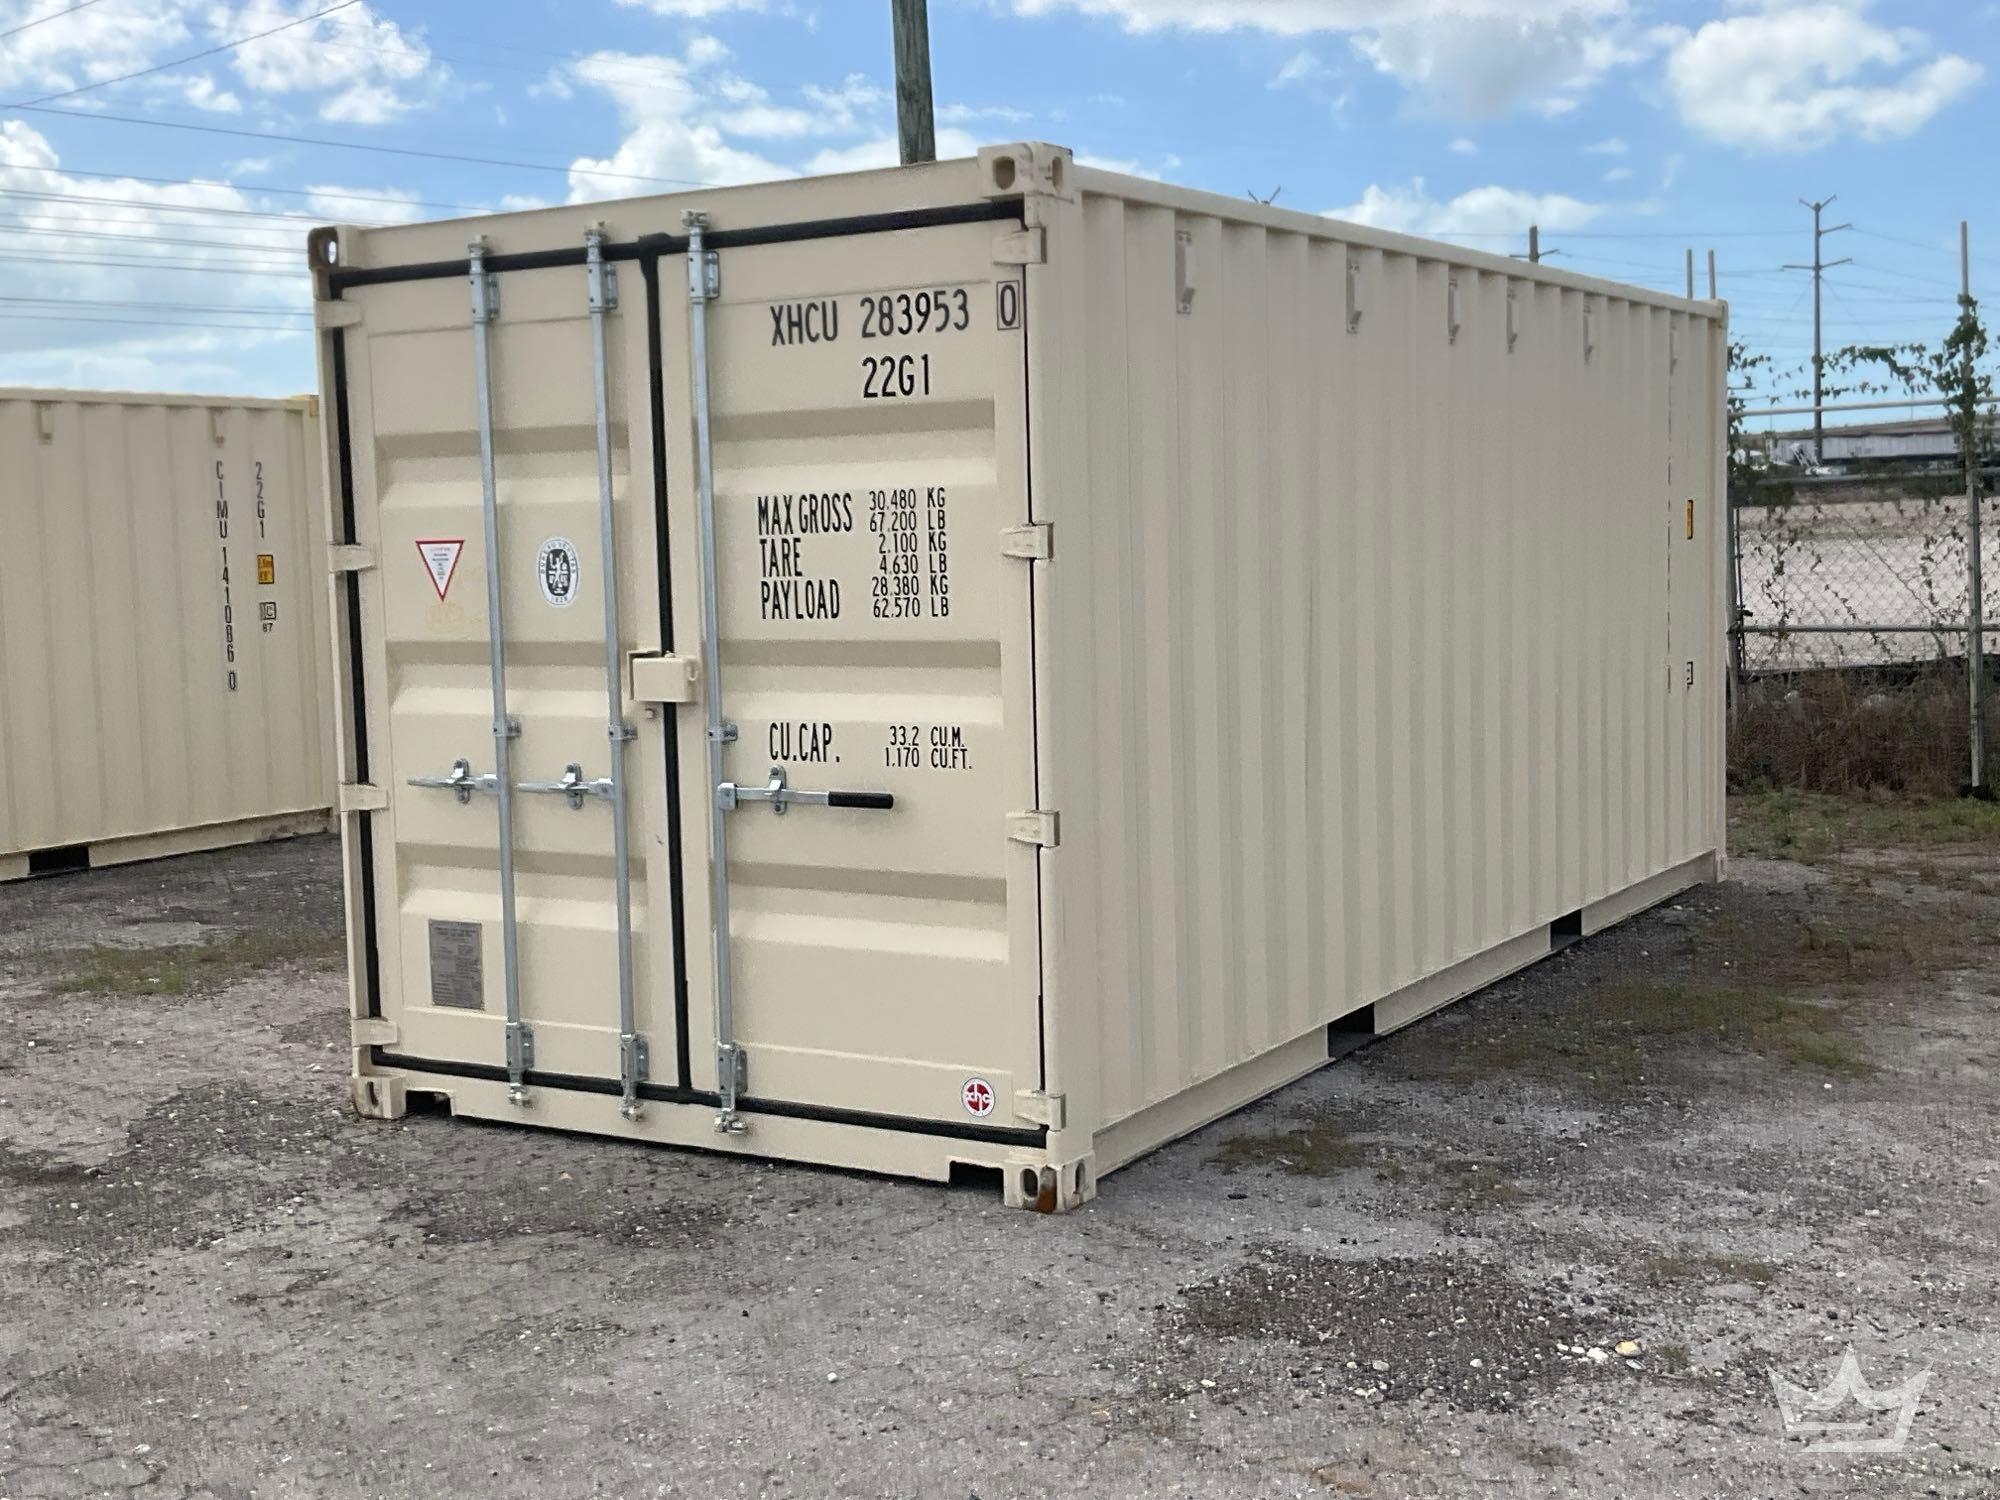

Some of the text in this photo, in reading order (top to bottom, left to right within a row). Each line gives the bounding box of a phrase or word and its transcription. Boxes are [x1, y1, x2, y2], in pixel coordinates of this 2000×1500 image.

[769, 284, 1016, 346] XHCU 283953 0
[861, 354, 929, 398] 22G1
[215, 461, 228, 539] CIMU
[255, 461, 266, 538] 22G1
[757, 493, 853, 535] MAX GROSS
[869, 487, 946, 511] 30.480 KG
[869, 509, 946, 533] 67.200 LB
[759, 537, 803, 577] TARE
[878, 531, 947, 554] 2.100 KG
[879, 553, 948, 575] 4.630 LB
[760, 579, 841, 620] PAYLOAD
[871, 574, 949, 598] 28.380 KG
[873, 596, 950, 618] 62.570 LB
[769, 722, 841, 763] CU.CAP.
[889, 725, 965, 748] 33.2 CU.M.
[885, 747, 920, 767] 1.170
